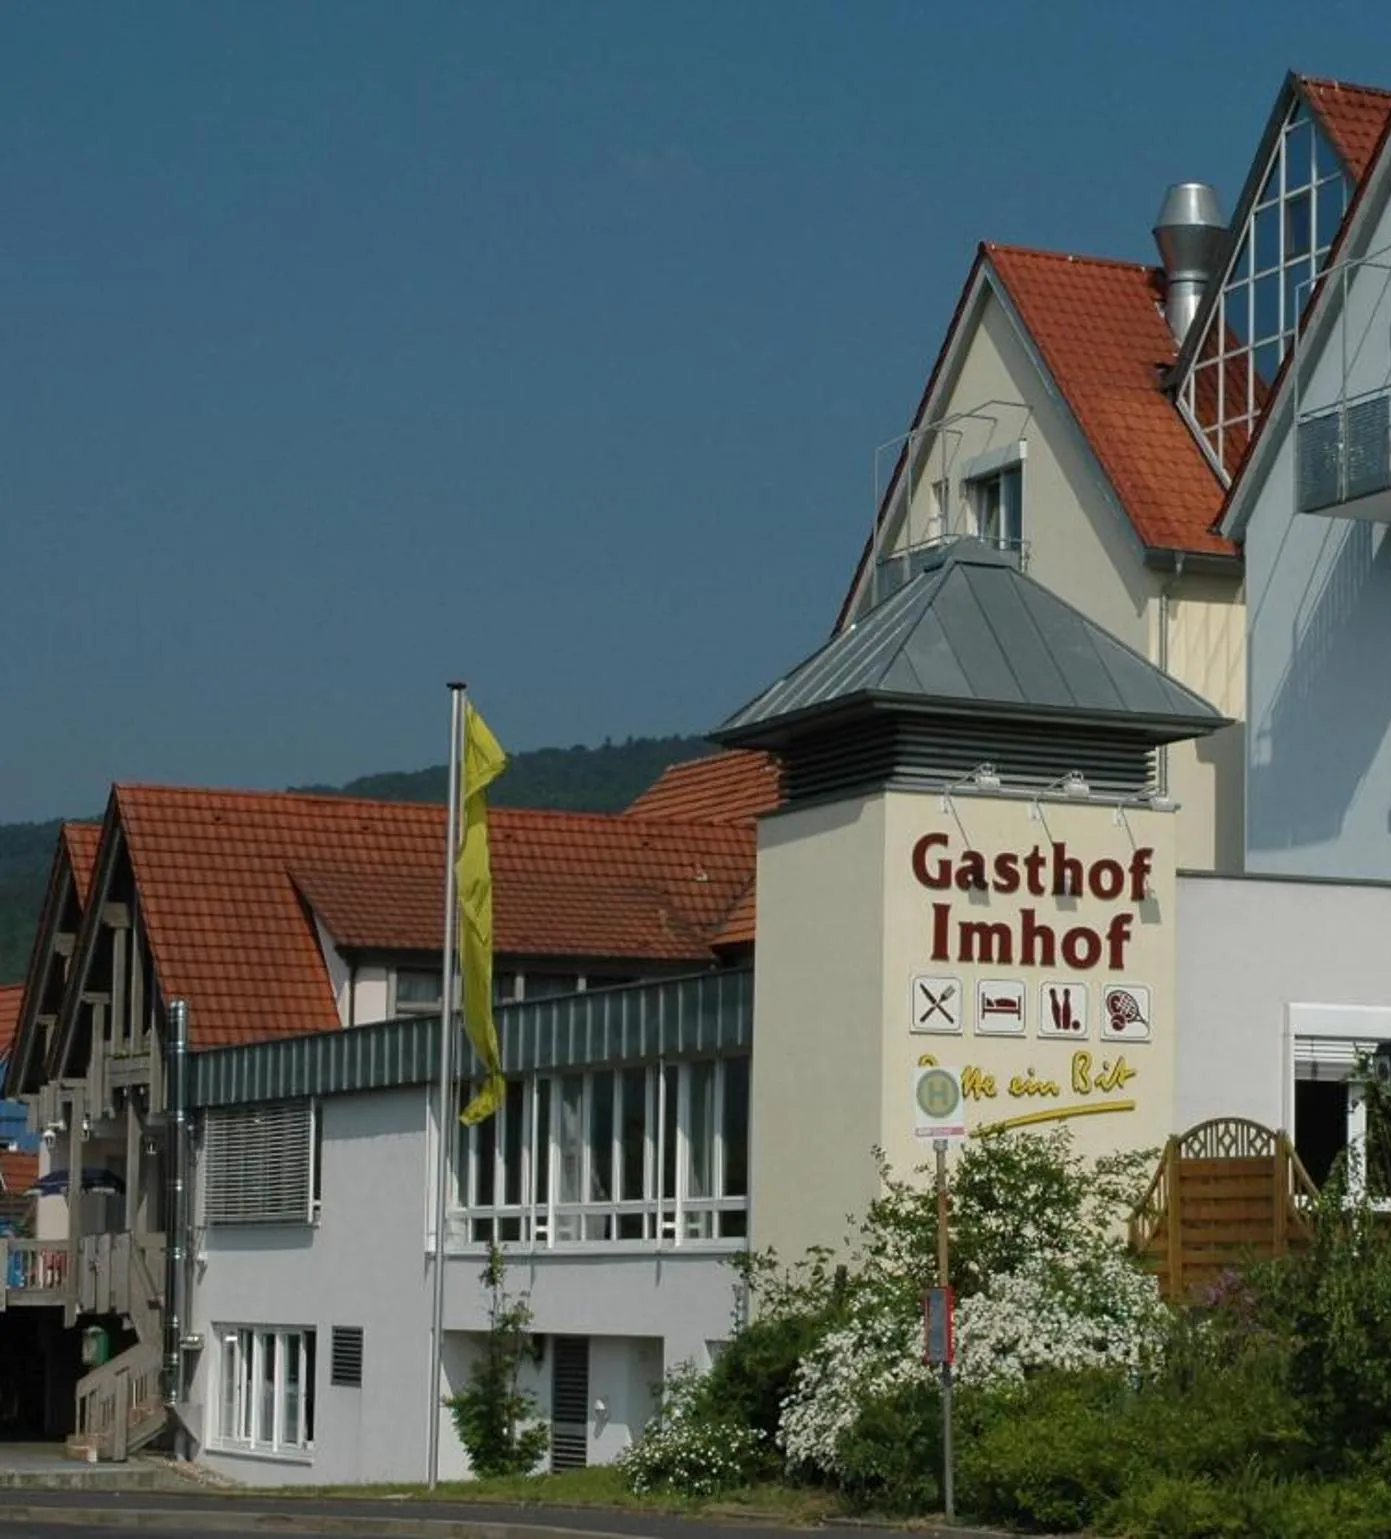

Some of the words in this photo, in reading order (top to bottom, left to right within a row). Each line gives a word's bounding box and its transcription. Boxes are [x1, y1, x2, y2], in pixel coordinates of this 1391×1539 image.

[911, 832, 1154, 901] Gasthof
[929, 902, 1134, 971] Imhof
[918, 1054, 998, 1101] tte
[1008, 1066, 1060, 1098] ein
[1071, 1050, 1138, 1096] Bit
[927, 1080, 949, 1107] H
